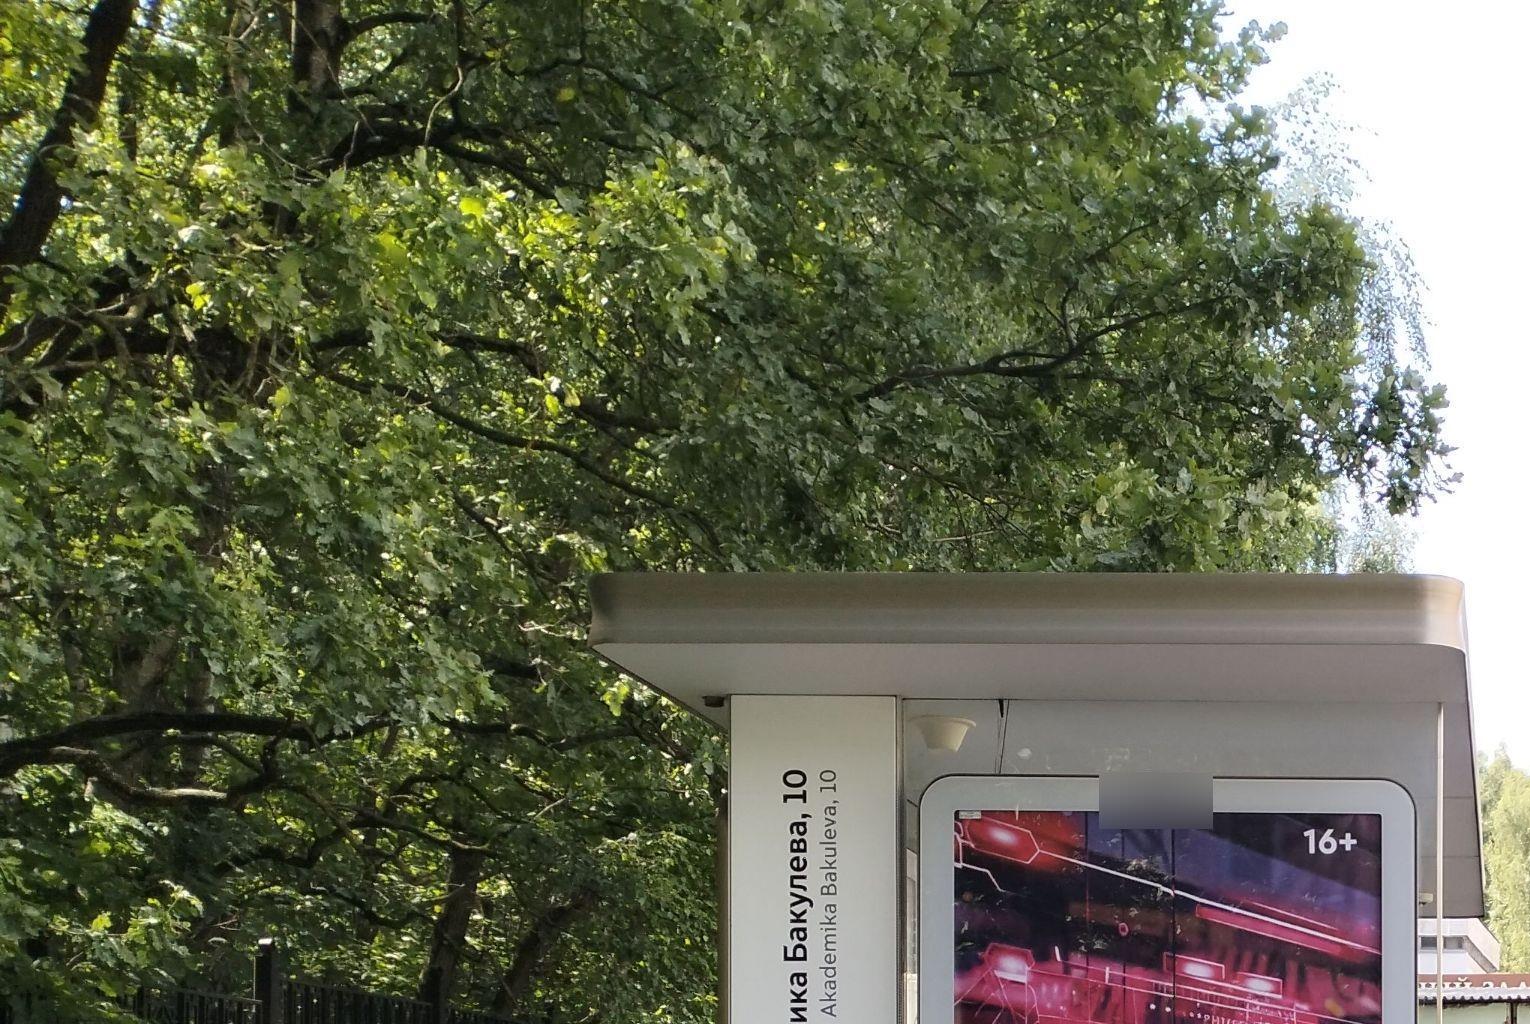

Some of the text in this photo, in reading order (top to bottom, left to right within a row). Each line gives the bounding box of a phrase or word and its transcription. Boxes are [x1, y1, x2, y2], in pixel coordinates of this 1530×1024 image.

[782, 769, 808, 804] 10
[819, 769, 837, 793] 10
[819, 800, 839, 896] Bakuleva,
[1303, 828, 1358, 855] 16+
[783, 813, 814, 962] Бакулева,
[819, 903, 838, 1018] Akademika
